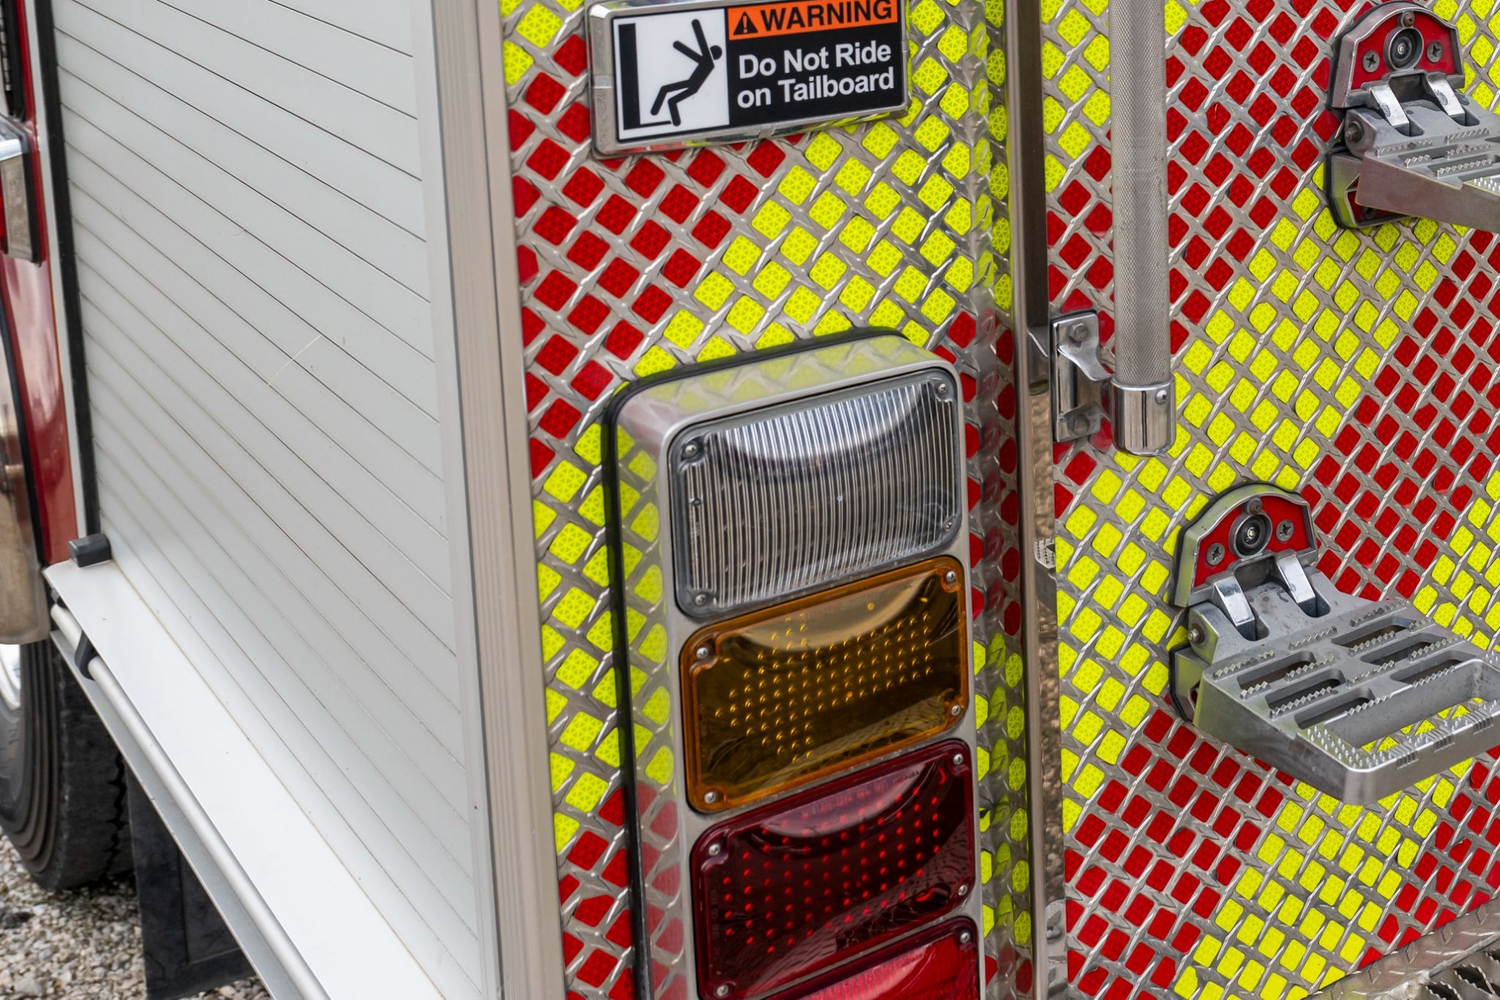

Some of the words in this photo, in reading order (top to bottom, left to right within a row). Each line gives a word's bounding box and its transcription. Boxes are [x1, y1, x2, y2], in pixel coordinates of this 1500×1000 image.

[739, 54, 776, 79] Do
[784, 48, 829, 74] Not
[836, 40, 891, 68] Ride
[737, 88, 772, 108] on
[778, 68, 895, 103] Tailboard
